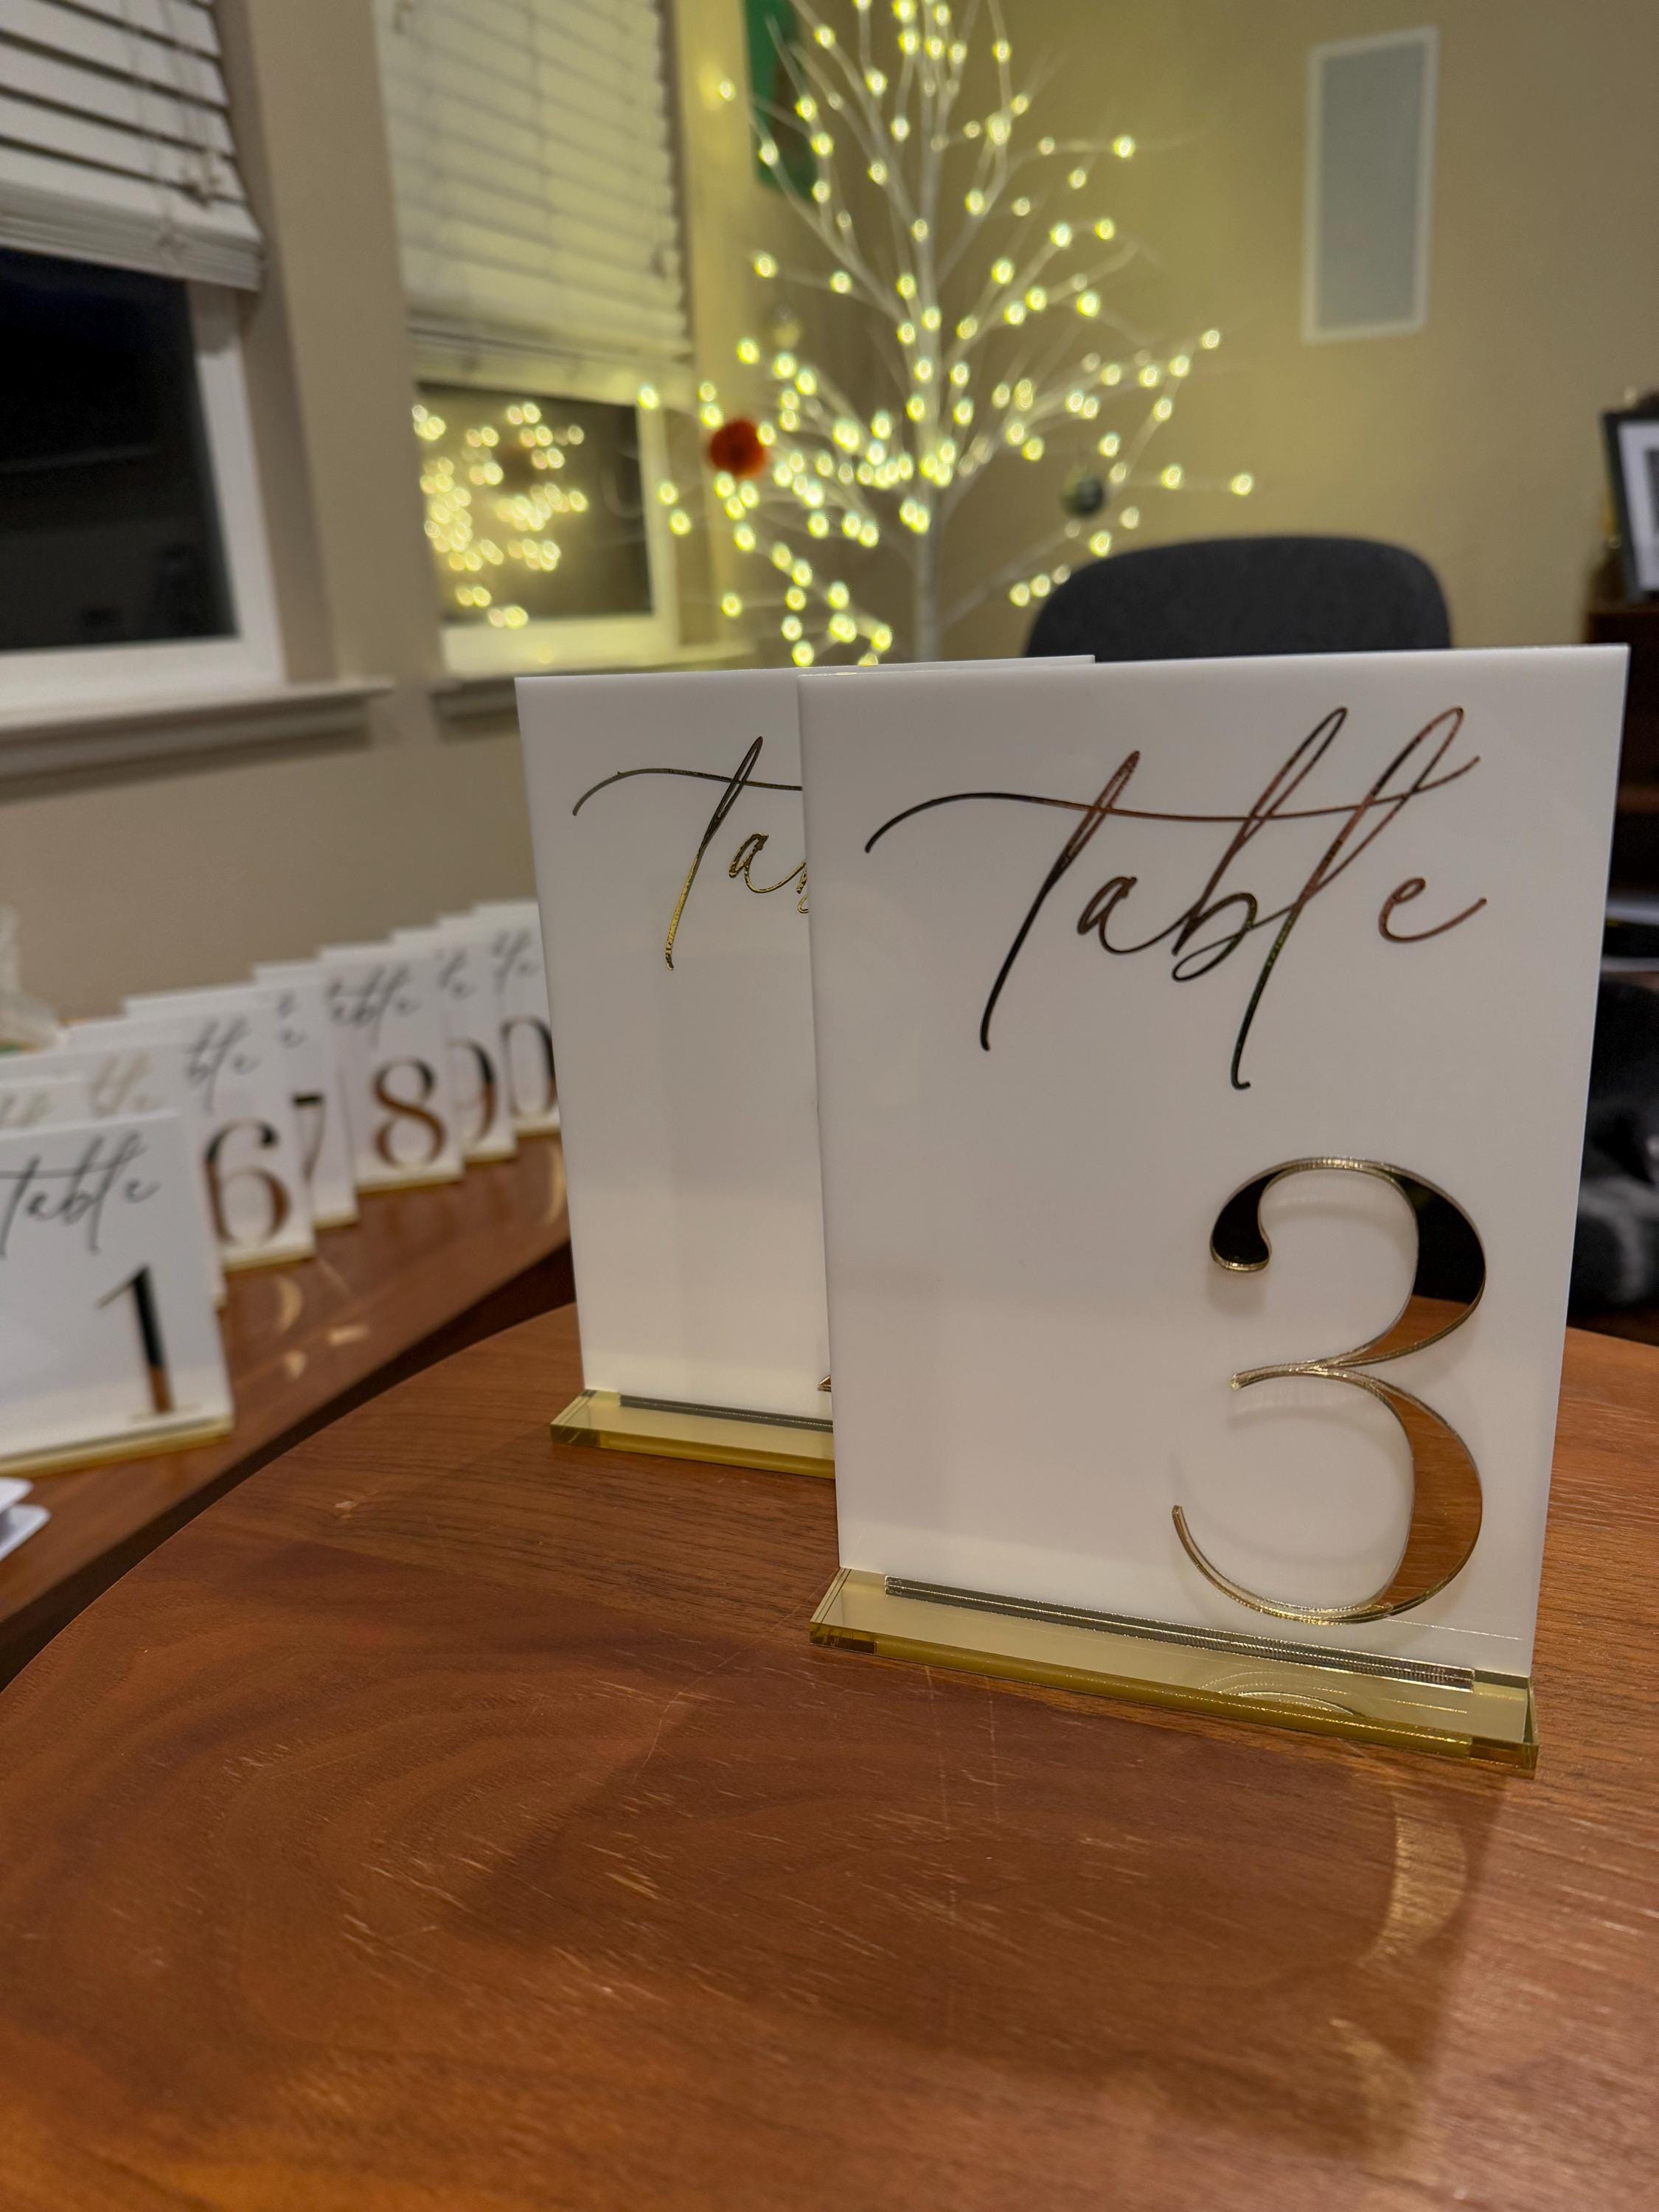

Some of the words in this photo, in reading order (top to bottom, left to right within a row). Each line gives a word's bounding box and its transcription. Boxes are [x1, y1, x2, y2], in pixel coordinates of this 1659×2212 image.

[865, 706, 1486, 1089] Table
[204, 1117, 292, 1248] 6
[372, 1056, 447, 1169] 8
[97, 1264, 202, 1423] 1
[1172, 1155, 1486, 1626] 3
